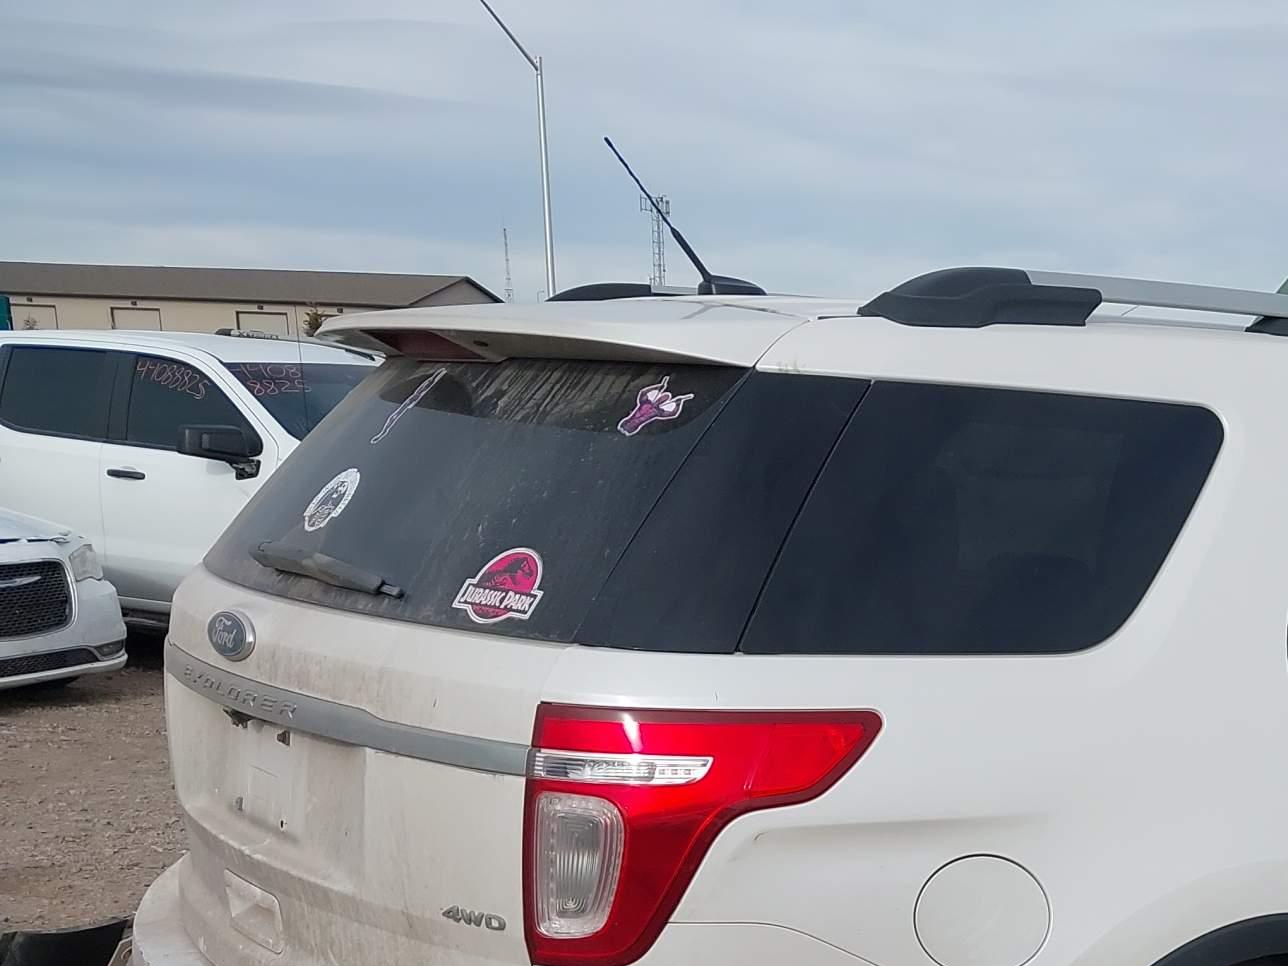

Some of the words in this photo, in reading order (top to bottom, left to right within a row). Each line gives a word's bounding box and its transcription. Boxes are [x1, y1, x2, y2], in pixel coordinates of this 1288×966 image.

[460, 584, 506, 608] JURASSIC
[500, 590, 534, 612] PARK
[213, 616, 237, 649] Ford
[183, 664, 297, 719] EXPLORER
[442, 905, 507, 931] 4WD
